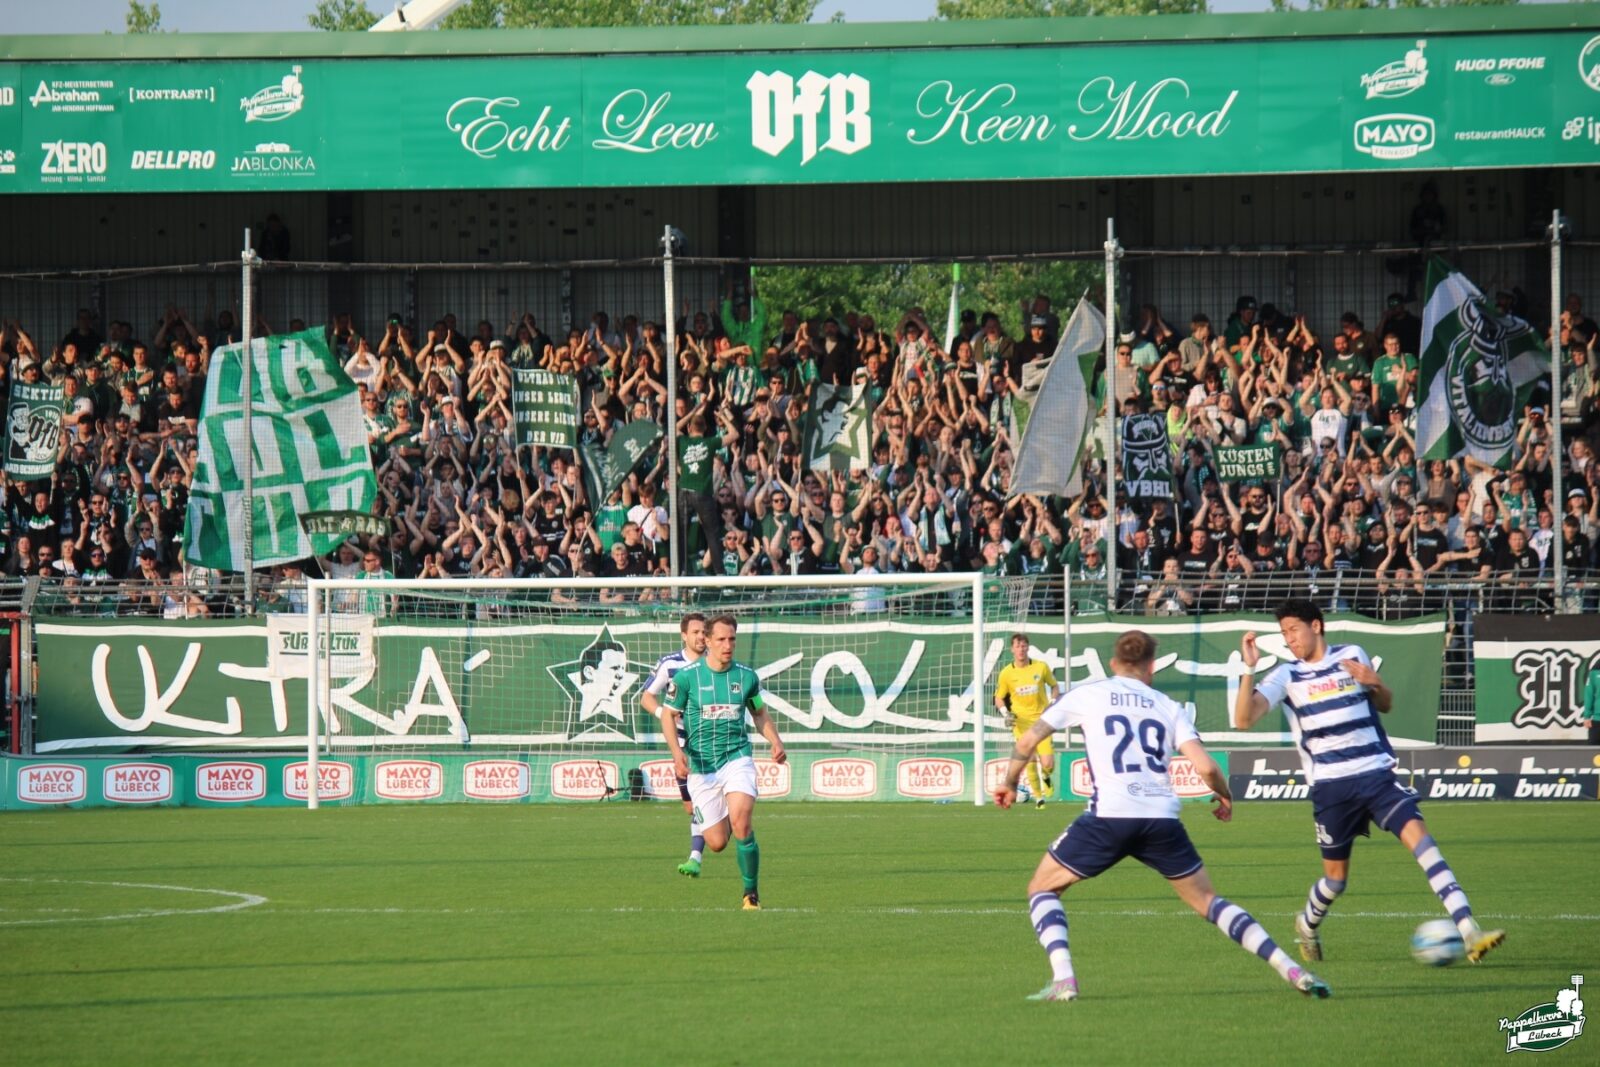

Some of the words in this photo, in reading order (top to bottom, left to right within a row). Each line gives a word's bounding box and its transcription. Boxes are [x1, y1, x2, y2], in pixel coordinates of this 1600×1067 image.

[1455, 59, 1496, 71] HUGO
[1498, 57, 1545, 70] PFOHE
[29, 80, 99, 107] Abraham
[907, 80, 1056, 145] Keen
[1068, 76, 1239, 141] Mood
[446, 97, 571, 158] Echt
[592, 89, 719, 153] Leev
[746, 70, 871, 166] VfB
[1363, 124, 1427, 143] MAYO
[1455, 127, 1545, 140] restaurantHAUCK
[131, 151, 216, 169] DELLPRO
[231, 156, 315, 171] JABLONKA
[14, 385, 64, 401] SEKTIO
[1218, 447, 1275, 464] KÜSTEN
[1219, 463, 1265, 478] JUNGS
[283, 632, 359, 650] SUBULTUR
[1104, 714, 1167, 774] 29
[29, 771, 75, 782] MAYO
[115, 770, 161, 781] MAYO
[207, 769, 254, 780] MAYO
[295, 769, 341, 780] MYO
[386, 767, 431, 778] MAYO
[474, 767, 519, 778] MAYO
[562, 767, 607, 778] MAYO
[651, 767, 677, 778] MA
[757, 766, 780, 777] YO
[822, 766, 865, 777] MAYO
[908, 766, 952, 777] MAYO
[29, 783, 73, 793] LÜBECK
[115, 783, 160, 792] LÜBECK
[208, 781, 253, 791] LÜBECK
[295, 781, 340, 790] LÜECK
[386, 779, 430, 788] LÜBECK
[474, 779, 519, 788] LÜBECK
[562, 779, 605, 788] LÜBECK
[757, 778, 779, 787] ECK
[822, 778, 864, 787] LÜBECK
[908, 778, 951, 787] LÜBECK
[1430, 778, 1495, 798] bwin
[1515, 777, 1581, 798] bwin
[1244, 778, 1309, 799] bwin
